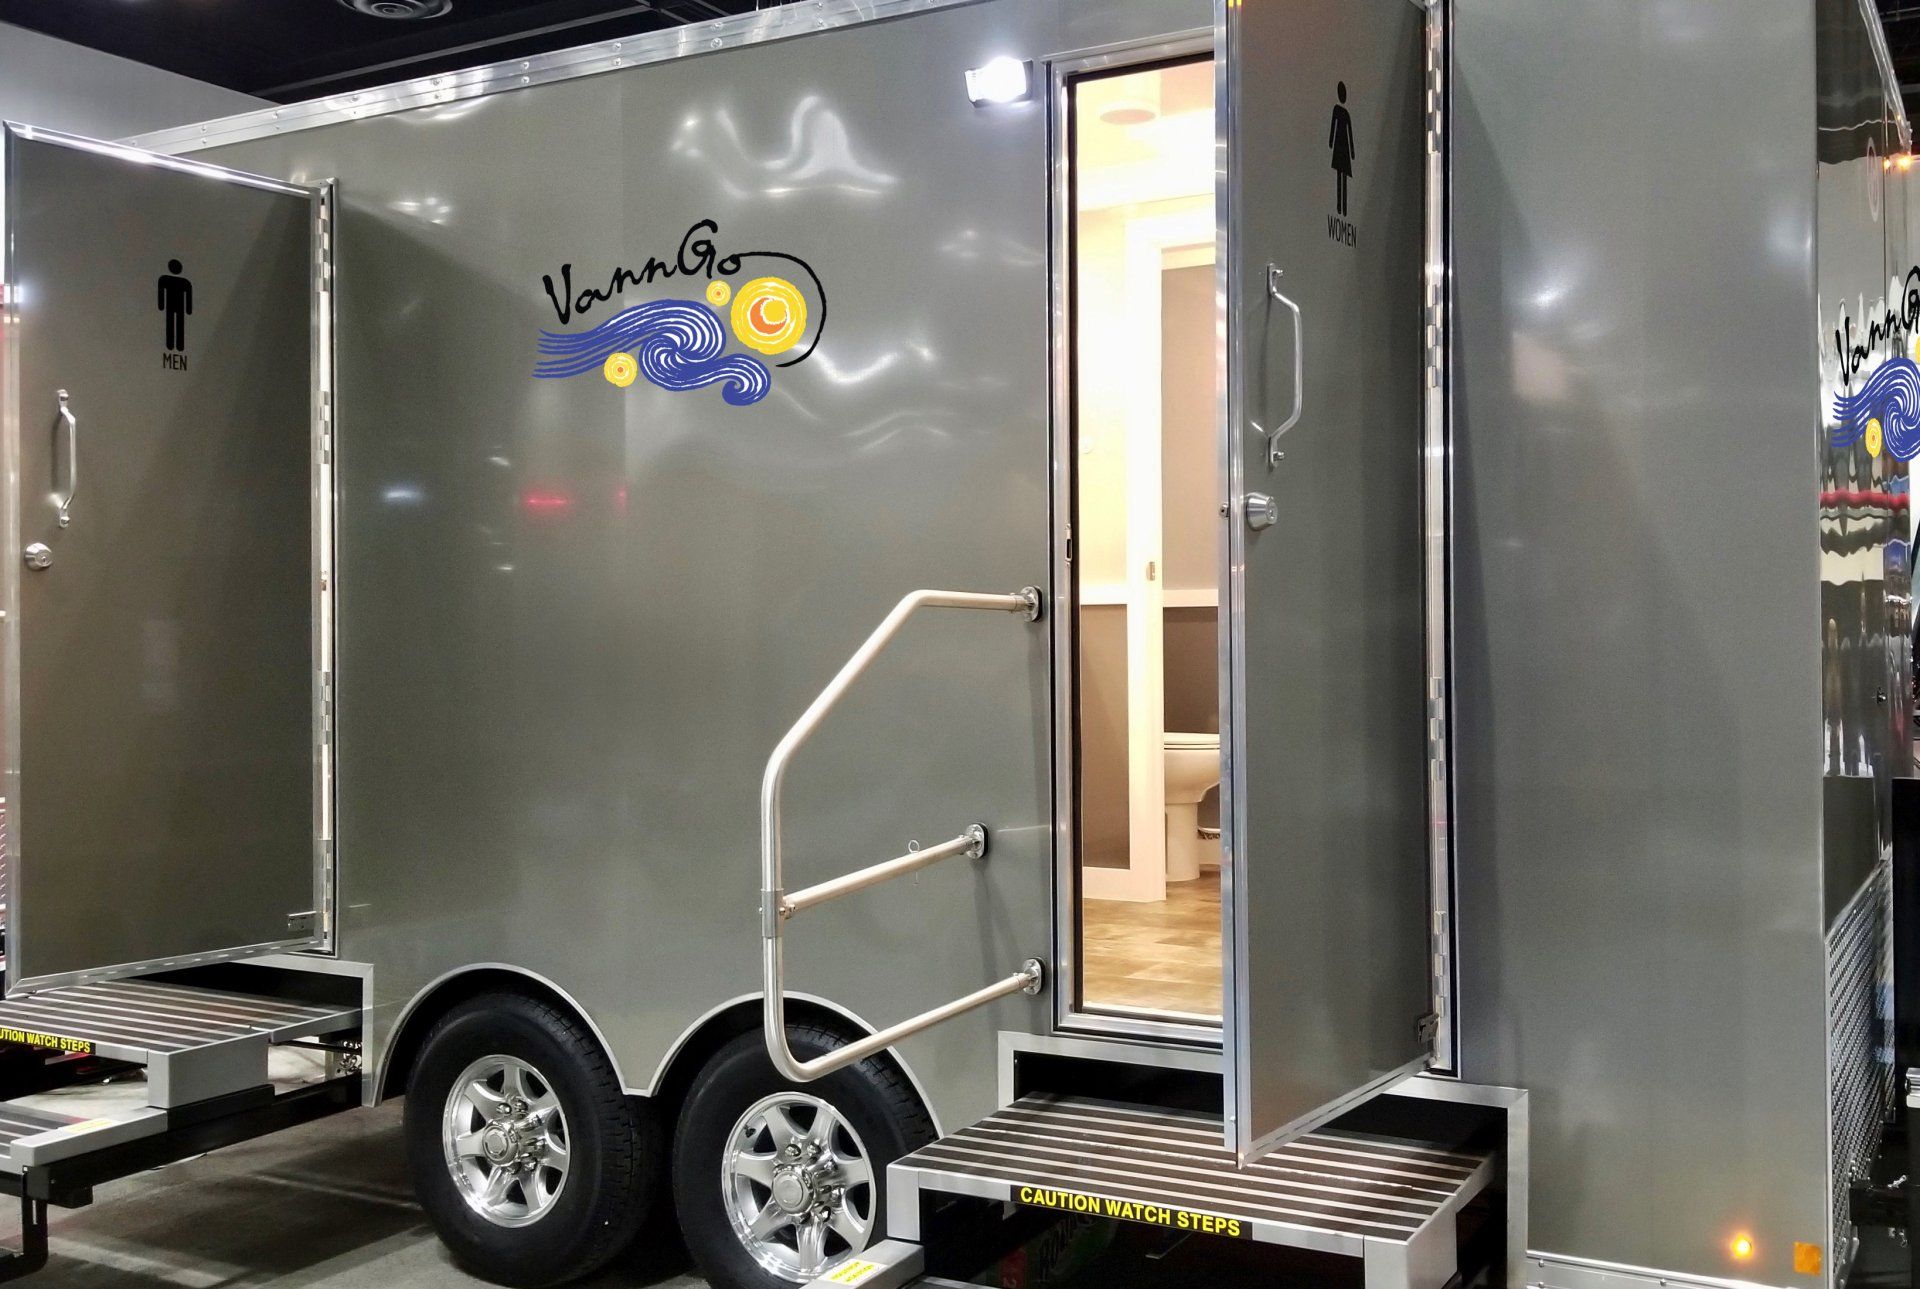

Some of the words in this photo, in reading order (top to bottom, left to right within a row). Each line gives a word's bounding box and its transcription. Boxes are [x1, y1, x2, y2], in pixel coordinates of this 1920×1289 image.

[1327, 214, 1357, 249] WOMEN
[542, 219, 741, 325] VannGo
[1836, 265, 1920, 386] VannG
[162, 352, 188, 371] MEN
[0, 1028, 24, 1042] UTION
[26, 1032, 58, 1048] WATCH
[60, 1038, 91, 1053] STEPS
[1020, 1187, 1101, 1214] CAUTION
[1105, 1199, 1171, 1225] WATCH
[1177, 1211, 1241, 1238] STEPS
